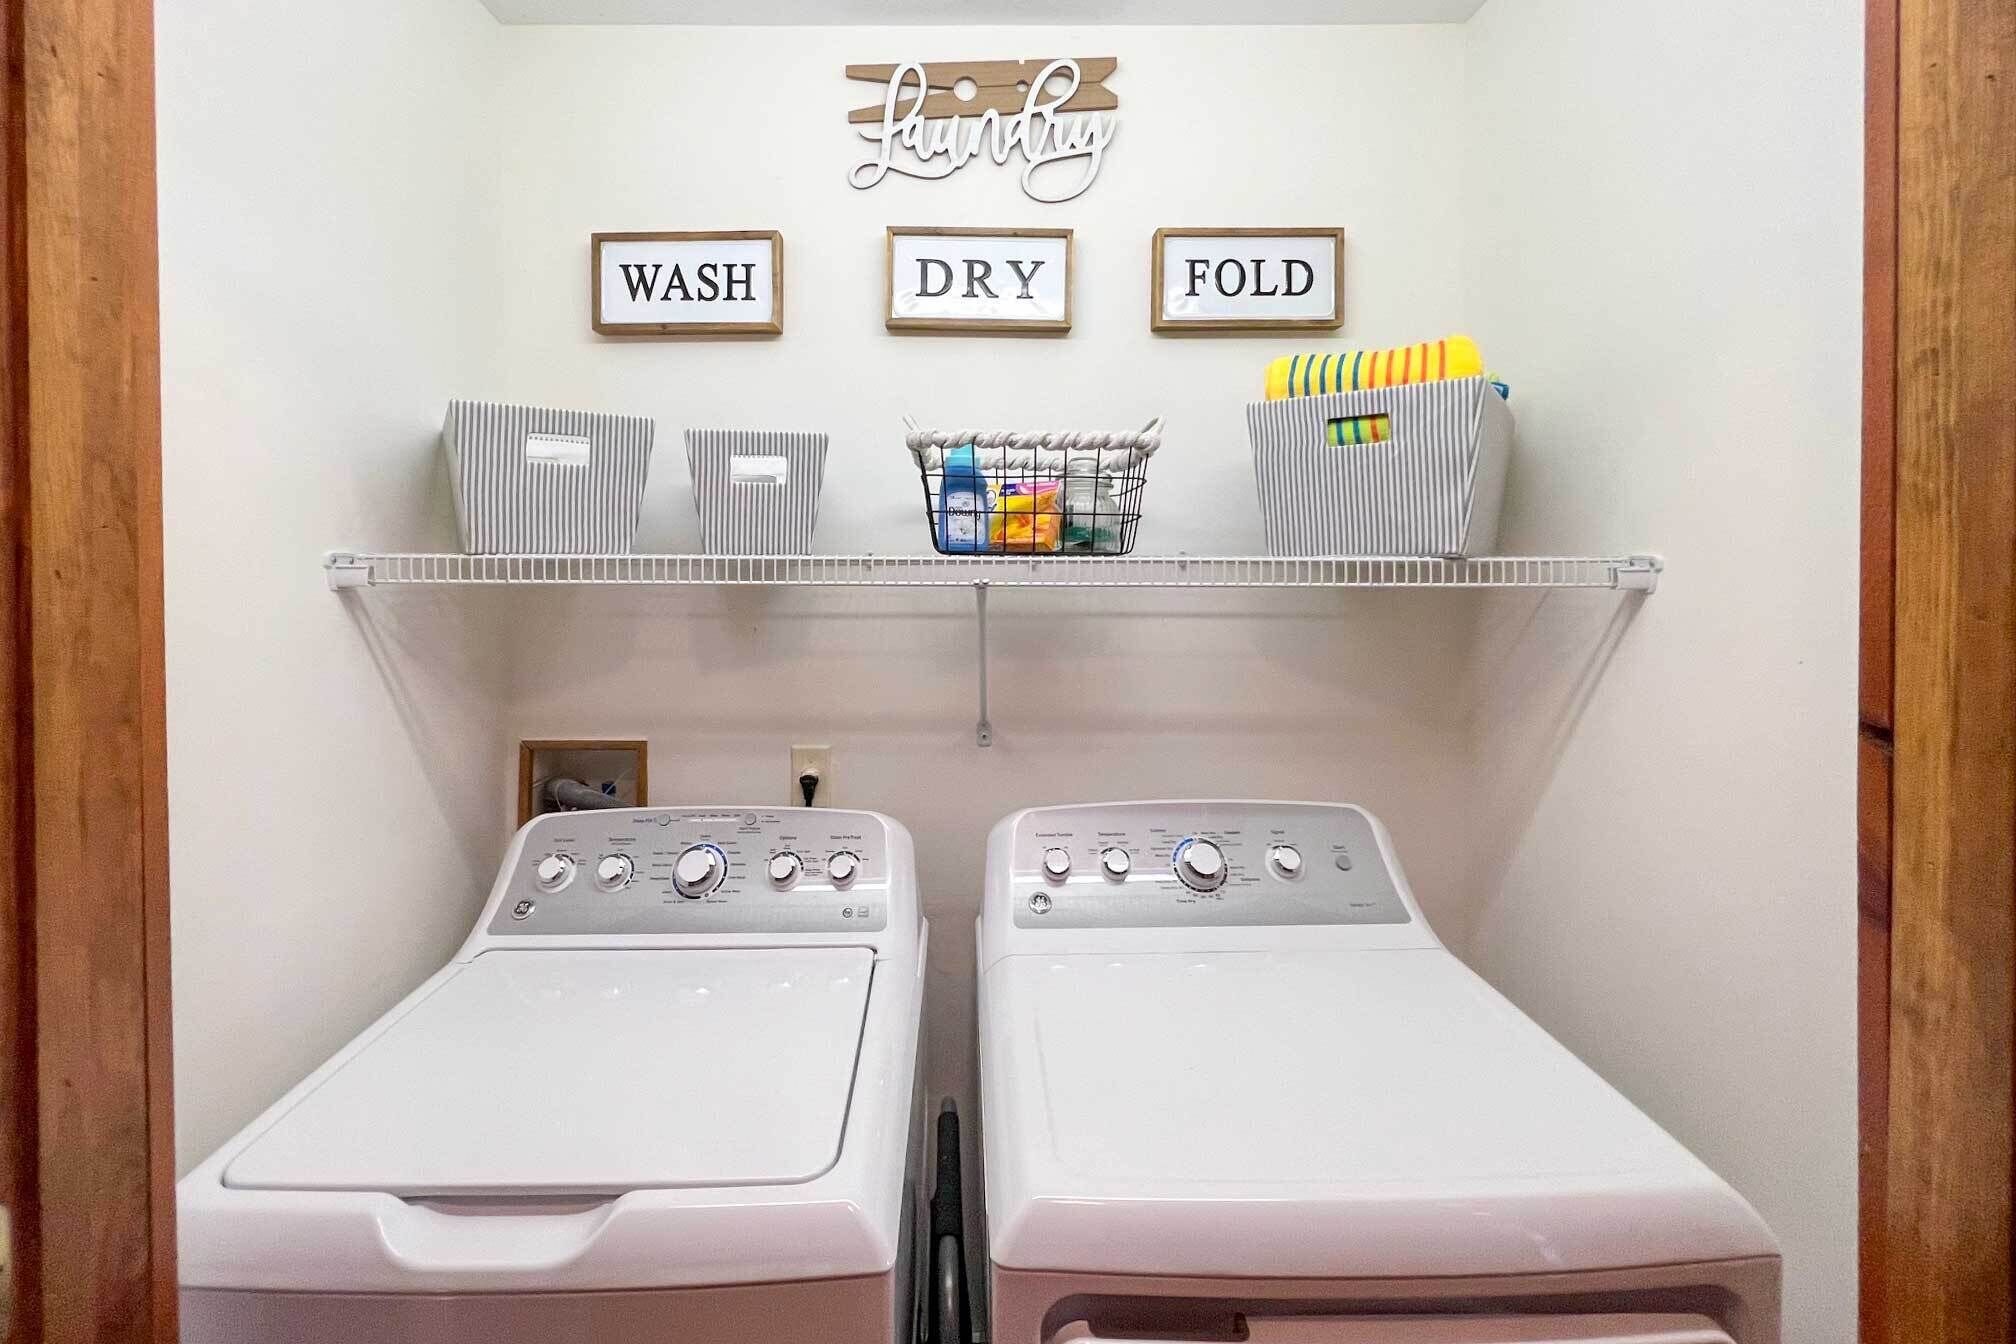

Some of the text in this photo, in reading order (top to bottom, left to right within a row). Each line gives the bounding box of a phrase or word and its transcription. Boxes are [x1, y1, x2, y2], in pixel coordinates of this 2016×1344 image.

[618, 263, 756, 302] WASH
[915, 258, 1046, 299] DRY
[1185, 258, 1314, 297] FOLD
